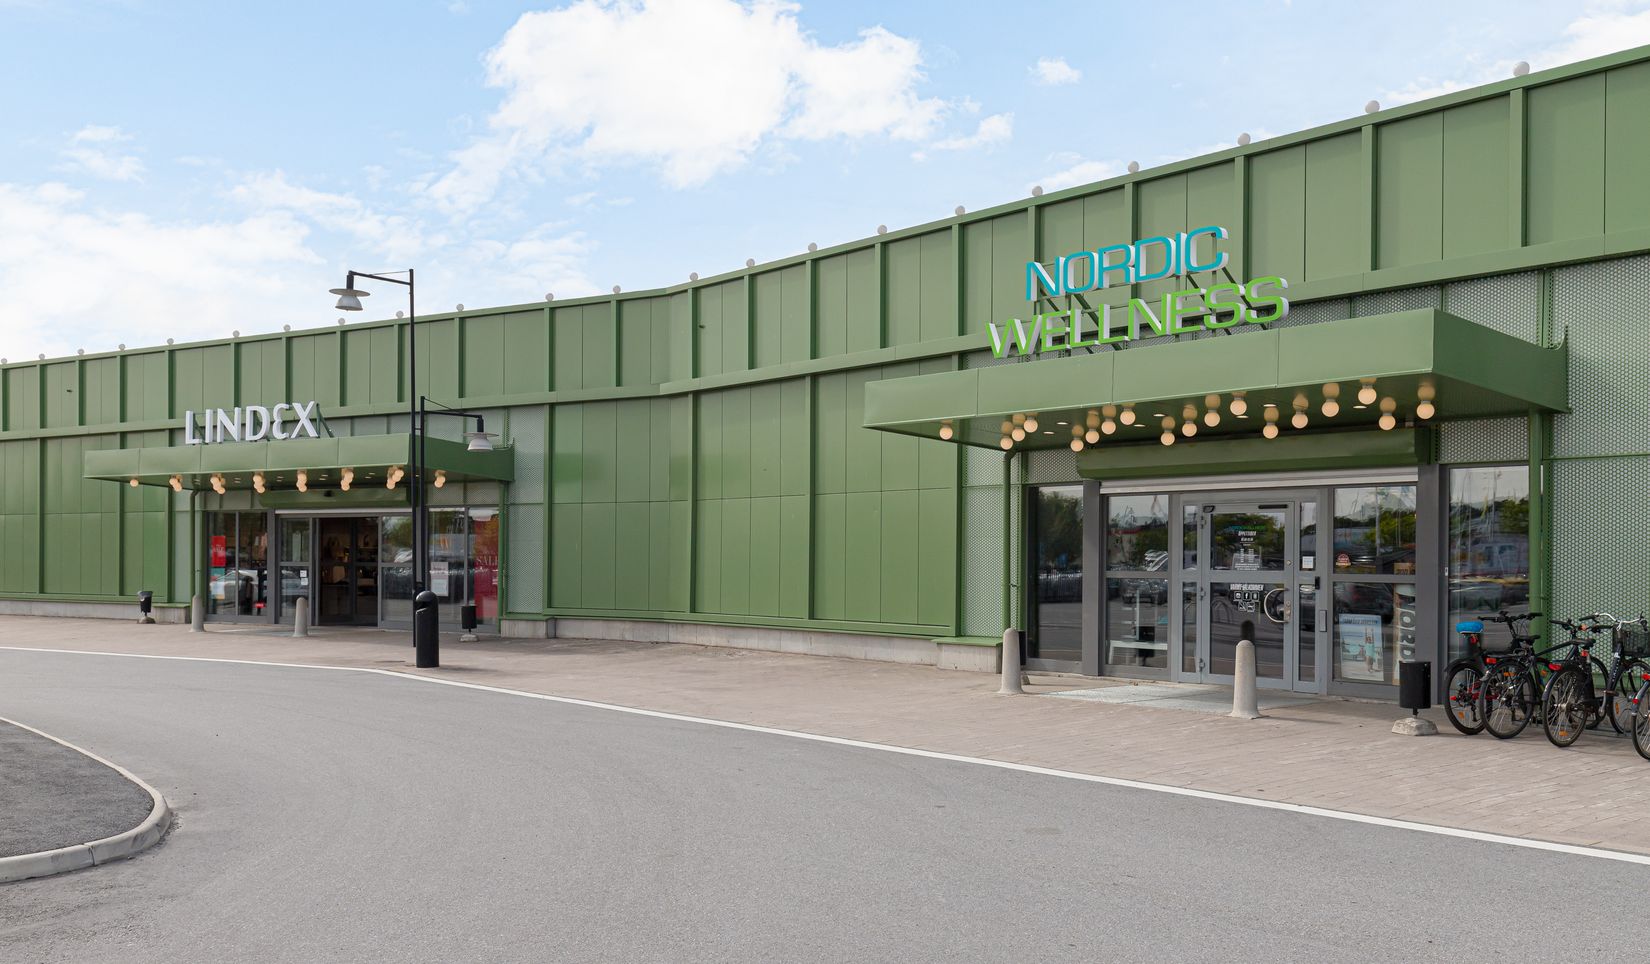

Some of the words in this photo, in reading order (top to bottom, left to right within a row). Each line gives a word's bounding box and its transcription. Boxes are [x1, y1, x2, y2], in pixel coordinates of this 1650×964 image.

[1026, 226, 1229, 301] NORDIC
[985, 276, 1289, 358] WELLNESS
[185, 401, 318, 444] LINDEX
